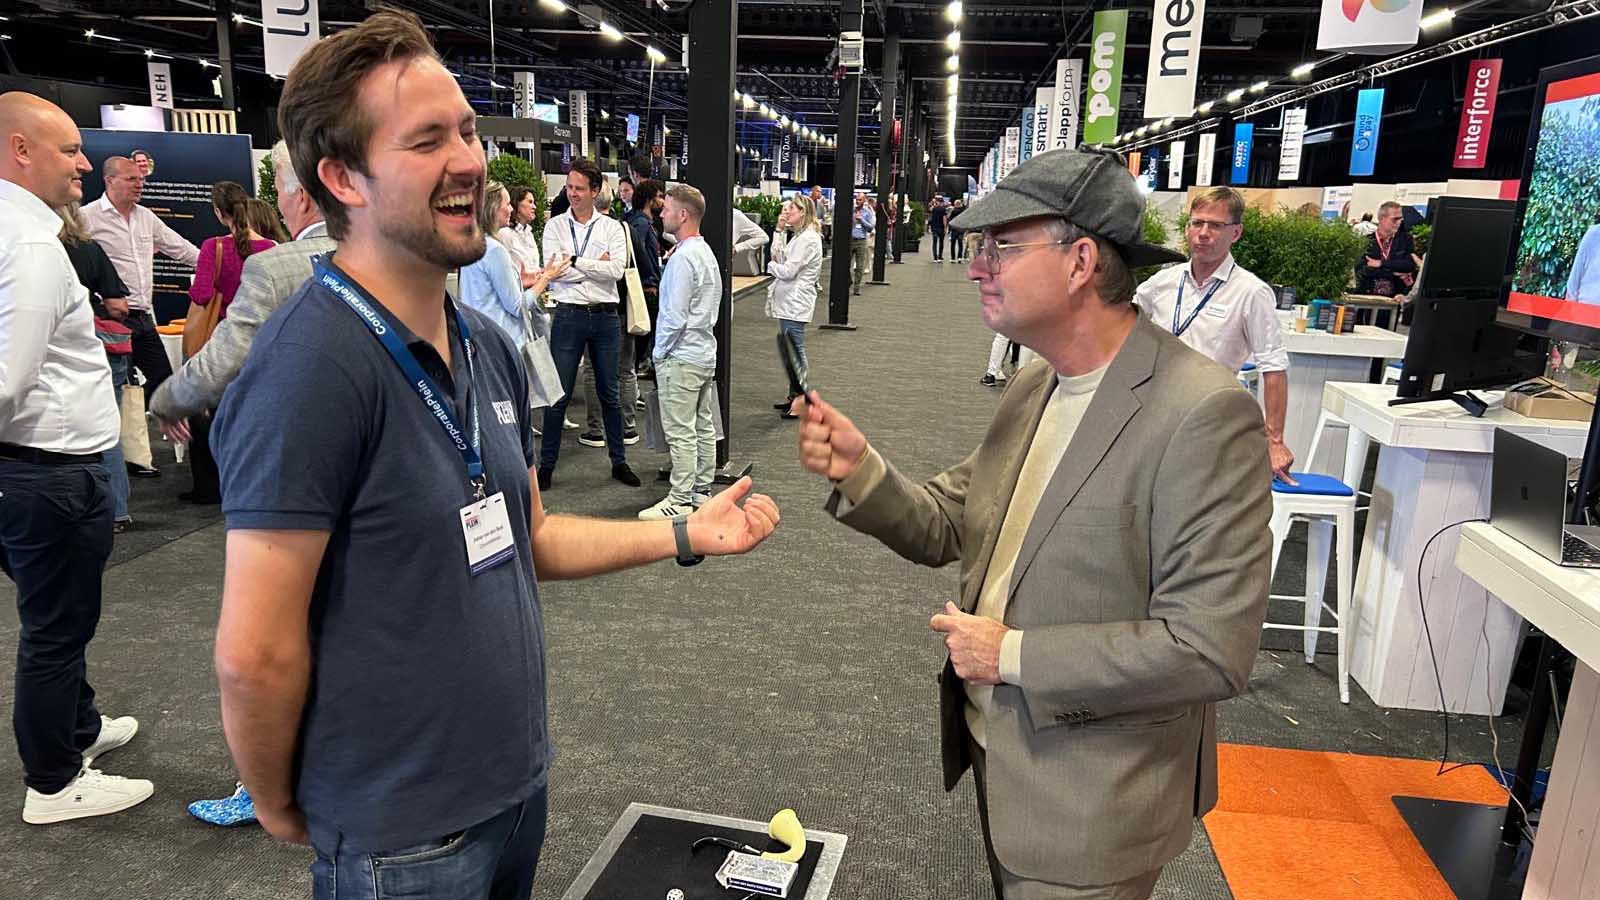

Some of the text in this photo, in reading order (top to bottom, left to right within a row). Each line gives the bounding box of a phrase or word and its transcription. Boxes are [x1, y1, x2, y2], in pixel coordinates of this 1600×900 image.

[1160, 0, 1195, 76] me
[155, 73, 167, 102] NEH
[1088, 32, 1116, 123] pom
[1459, 67, 1491, 160] interforce
[322, 274, 387, 335] CorporatiePlein
[417, 379, 467, 450] CorporatiePlein
